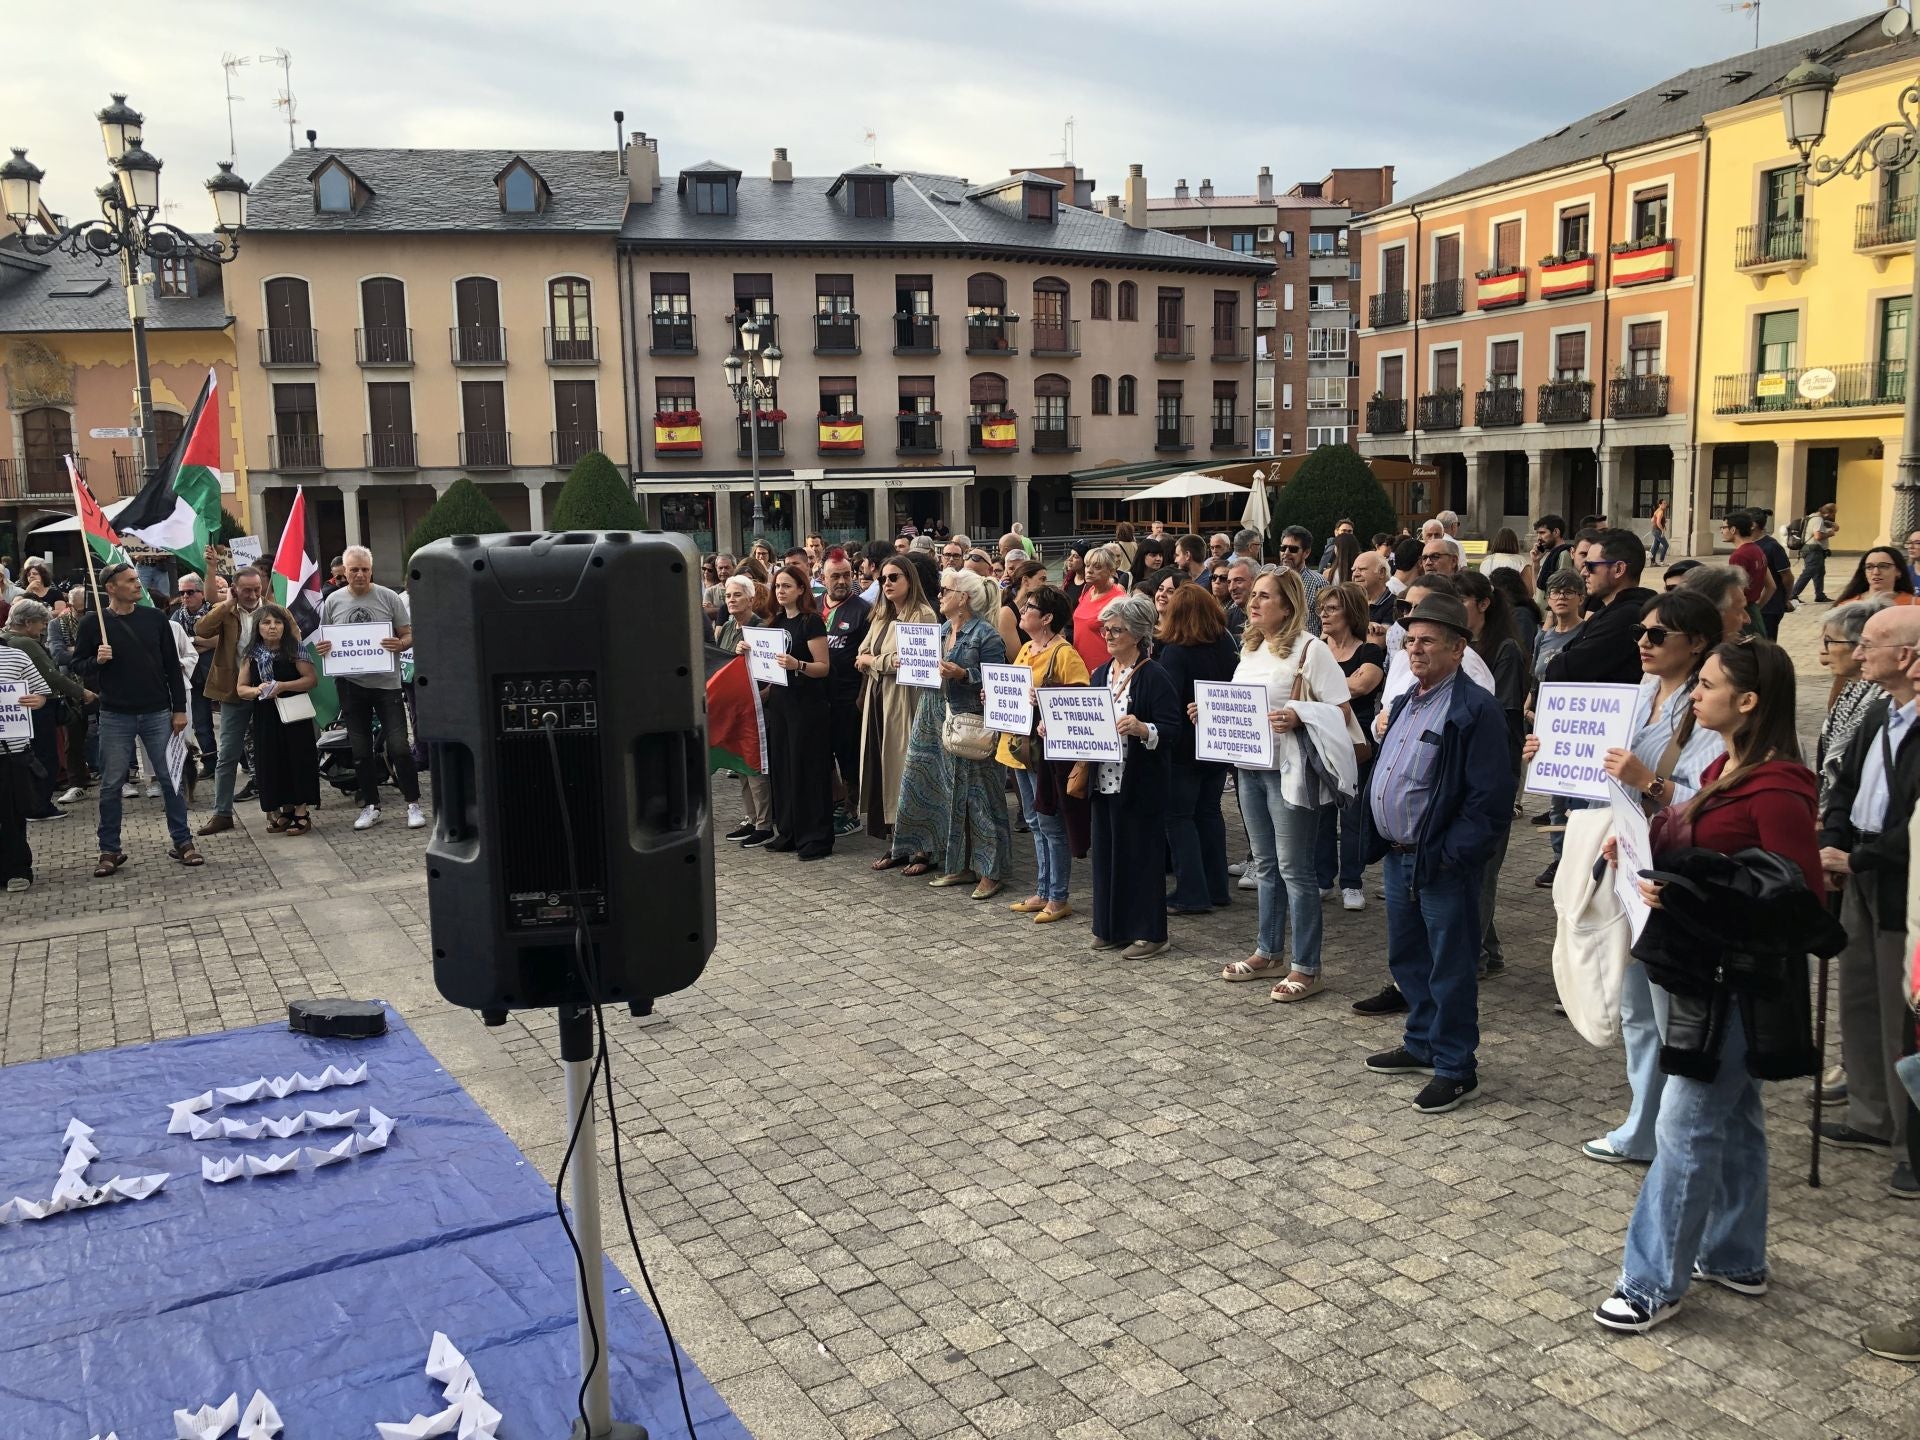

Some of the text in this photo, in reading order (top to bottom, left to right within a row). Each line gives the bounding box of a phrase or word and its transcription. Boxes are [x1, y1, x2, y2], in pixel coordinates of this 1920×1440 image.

[901, 626, 934, 636] PALESTINA
[756, 640, 769, 648] ALTO
[909, 638, 927, 646] LIBRE
[330, 648, 384, 658] GENOCIDIO
[753, 650, 759, 658] AL
[901, 648, 937, 657] GAZA LIBRE
[900, 657, 939, 668] CISJORDANIA
[912, 669, 930, 678] LIBRE
[988, 672, 1026, 683] NO ES UNA
[993, 685, 1022, 696] GUERRA
[1207, 688, 1229, 698] MATAR
[998, 699, 1019, 709] ES UN
[1049, 694, 1104, 708] ¿DÓNDE ESTÁ
[1547, 696, 1621, 713] NO ES UNA
[1205, 701, 1257, 713] Y BOMBARDEAR
[990, 711, 1027, 724] GENOCIDIO
[1052, 711, 1105, 721] EL TRIBUNAL
[1211, 715, 1253, 726] HOSPITALES
[1067, 726, 1094, 735] PENAL
[1551, 718, 1606, 737] GUERRA
[1207, 727, 1261, 740] NO ES DERECHO
[1048, 739, 1118, 752] INTERNACIONAL?
[1207, 740, 1262, 754] A AUTODEFENSA
[1554, 741, 1595, 758] ES UN
[1536, 761, 1608, 783] GENOCIDIO
